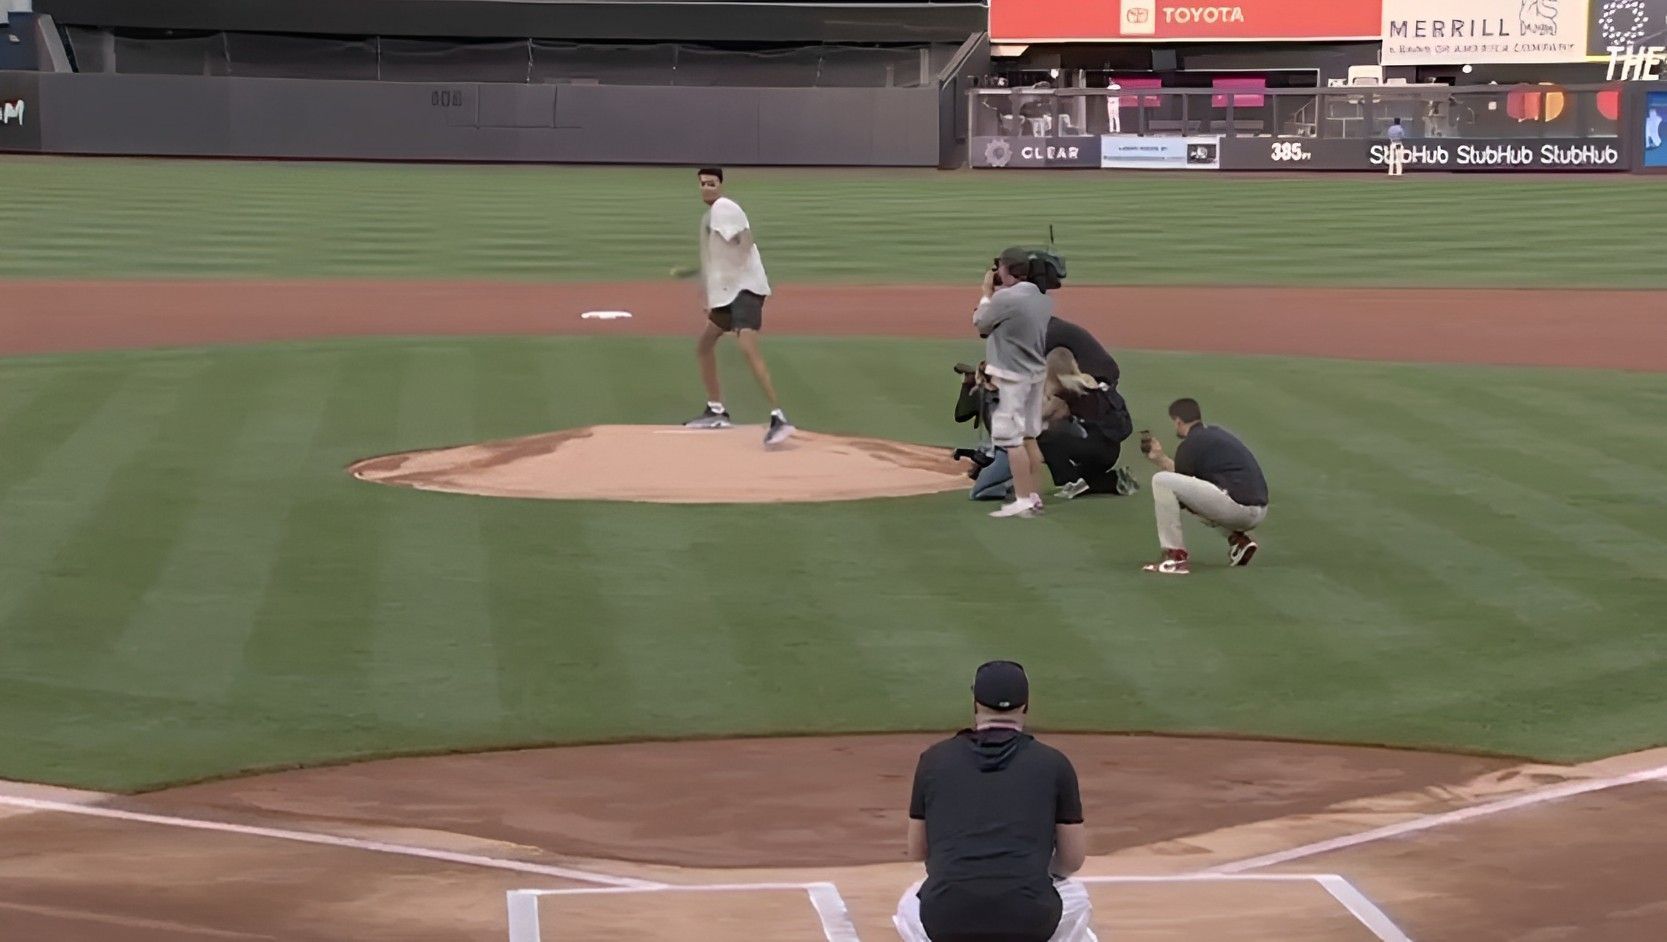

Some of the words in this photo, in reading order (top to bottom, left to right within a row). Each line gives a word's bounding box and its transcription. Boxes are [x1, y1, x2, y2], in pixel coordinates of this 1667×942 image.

[1163, 7, 1244, 23] TOYOTA
[1390, 18, 1510, 38] MERRILL
[1606, 46, 1666, 81] THE
[1021, 146, 1079, 159] CLEAR
[1369, 145, 1449, 164] StbHub
[1456, 145, 1534, 164] StubHub
[1540, 145, 1618, 164] StubHub
